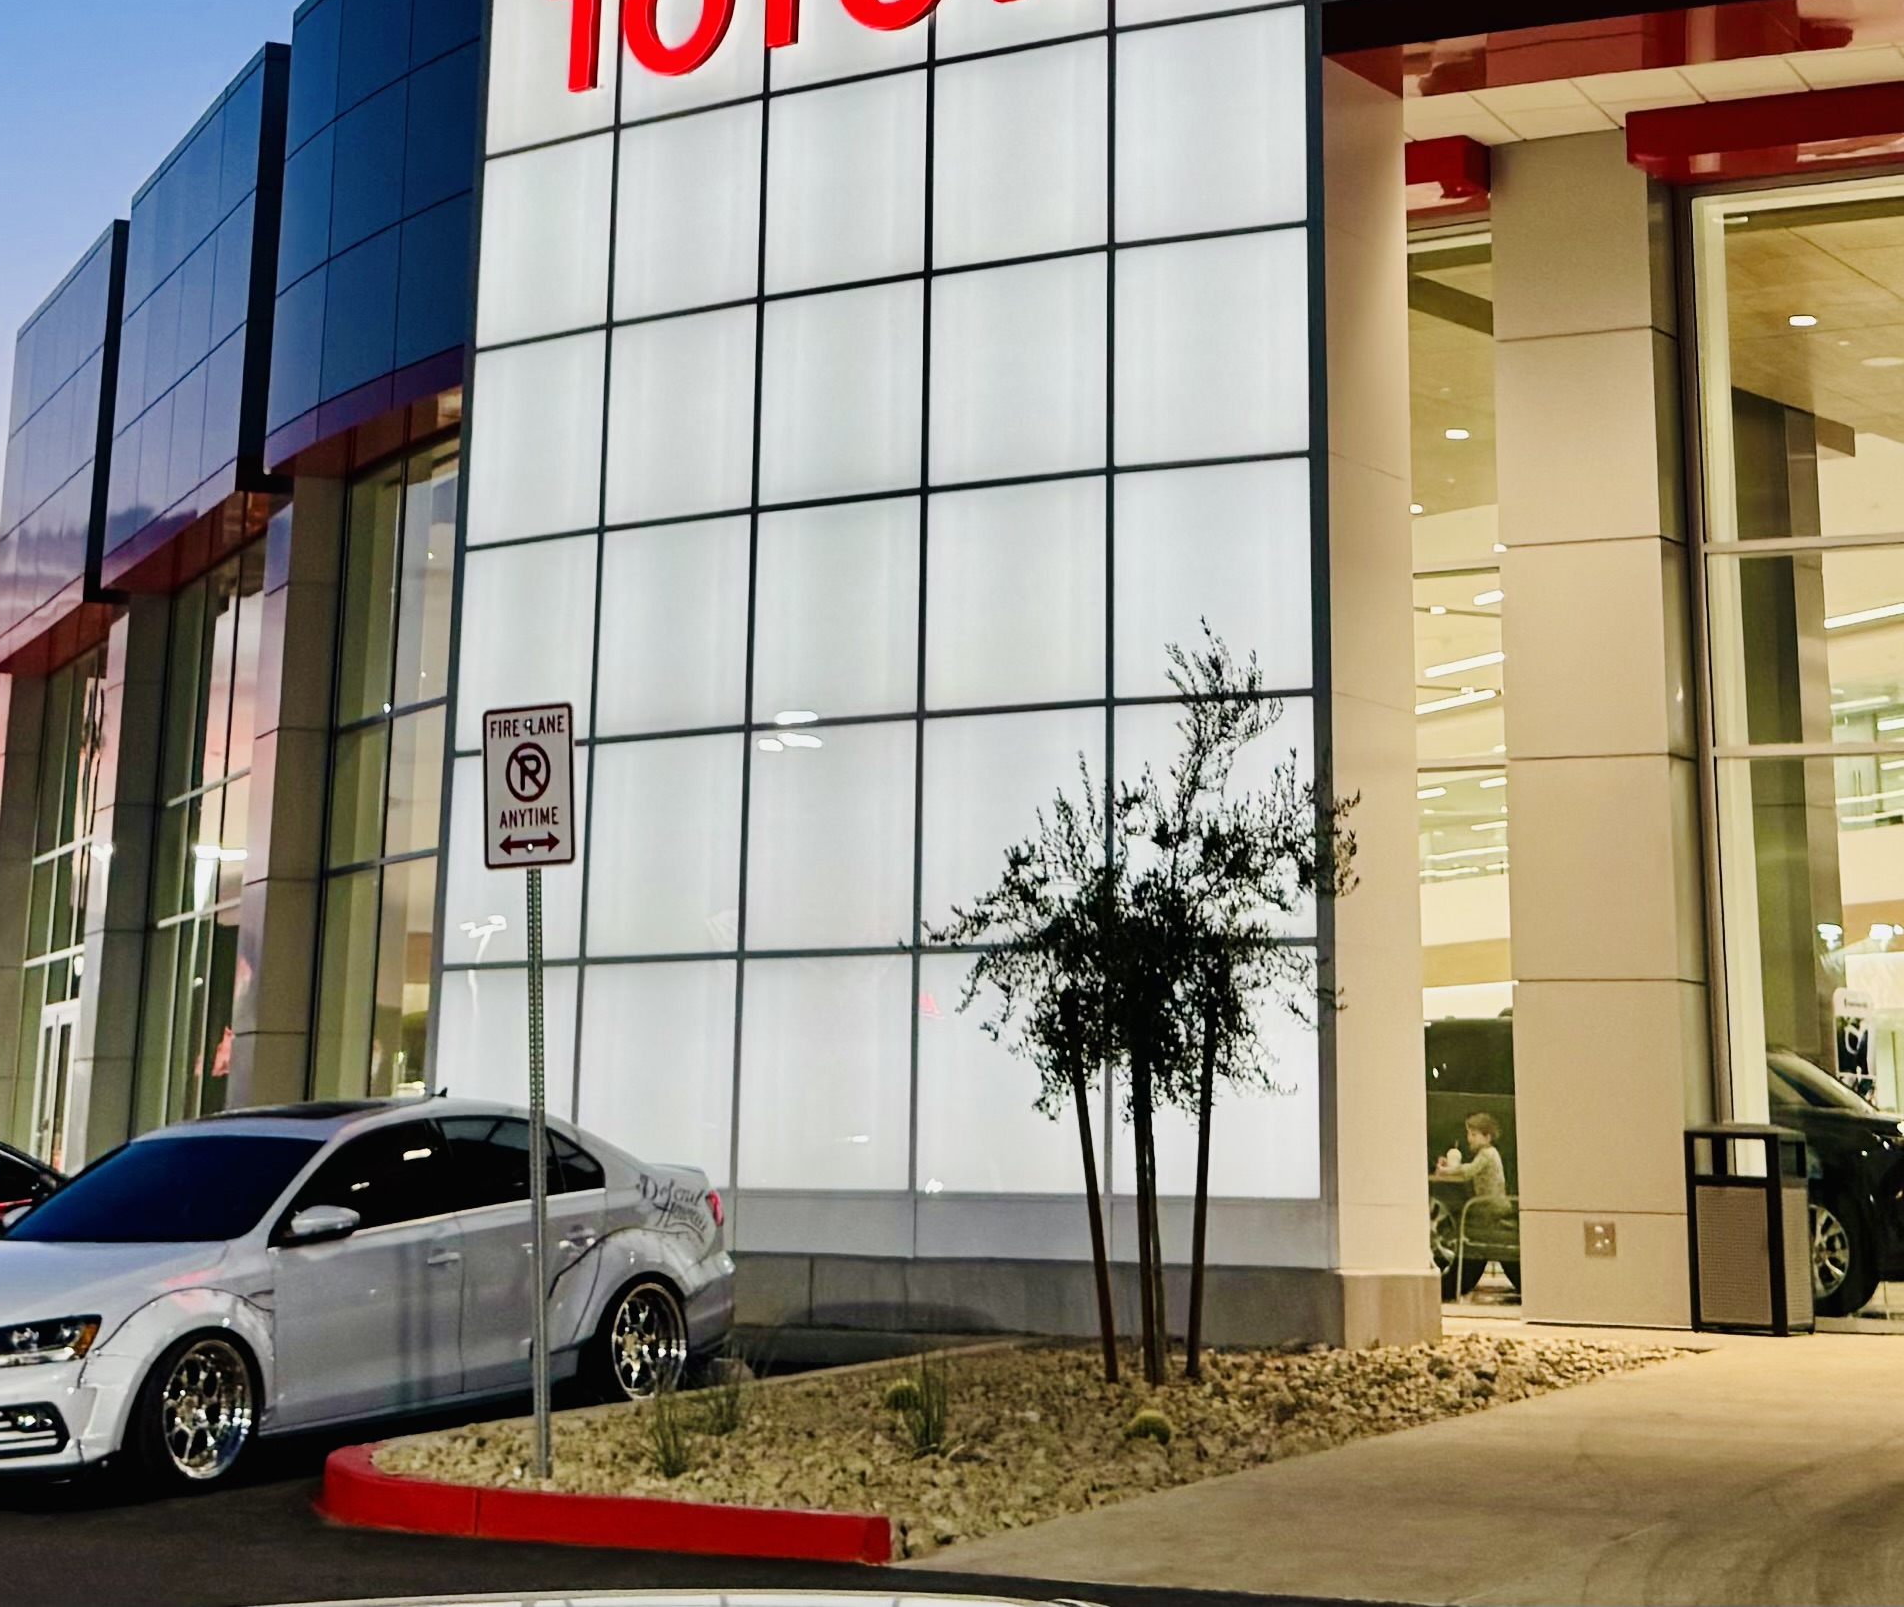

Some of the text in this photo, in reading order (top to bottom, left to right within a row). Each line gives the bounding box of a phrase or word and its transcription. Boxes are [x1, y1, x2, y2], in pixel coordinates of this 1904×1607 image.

[490, 714, 565, 739] FIRE LANE
[499, 806, 559, 830] ANYTIME
